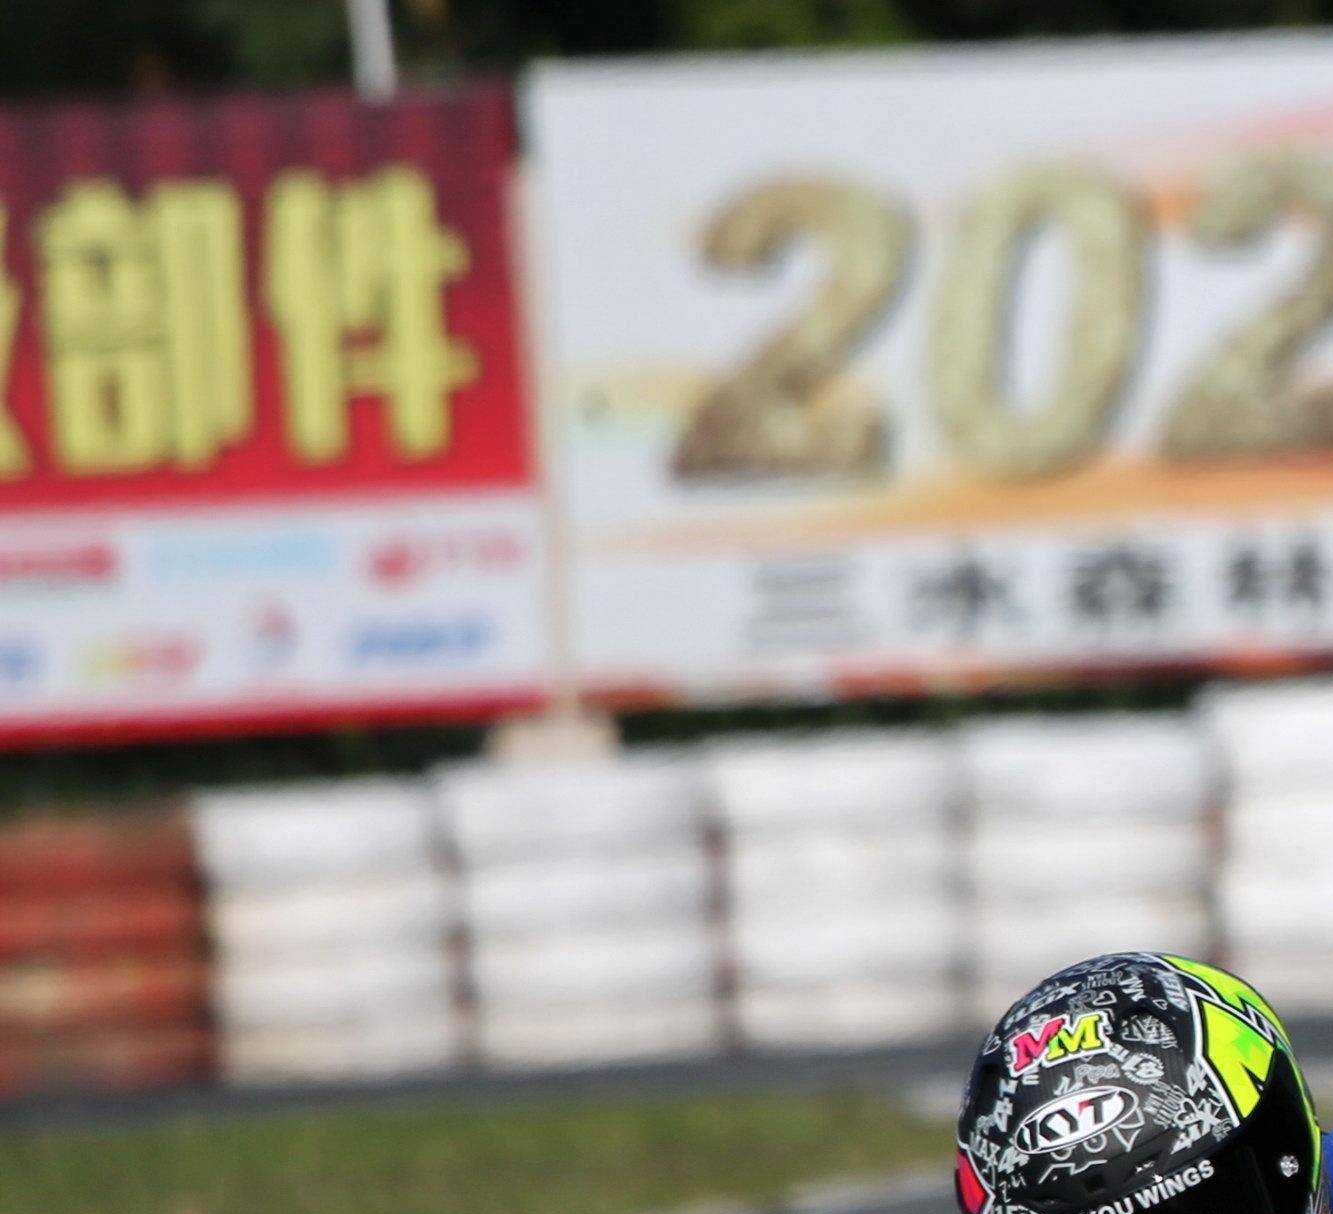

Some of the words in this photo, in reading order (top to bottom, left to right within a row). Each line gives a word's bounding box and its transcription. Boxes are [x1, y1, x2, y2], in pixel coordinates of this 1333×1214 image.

[0, 165, 482, 480] 部件
[1011, 1012, 1105, 1074] MM
[1018, 1092, 1118, 1151] KYT
[1134, 1159, 1215, 1210] WINGS
